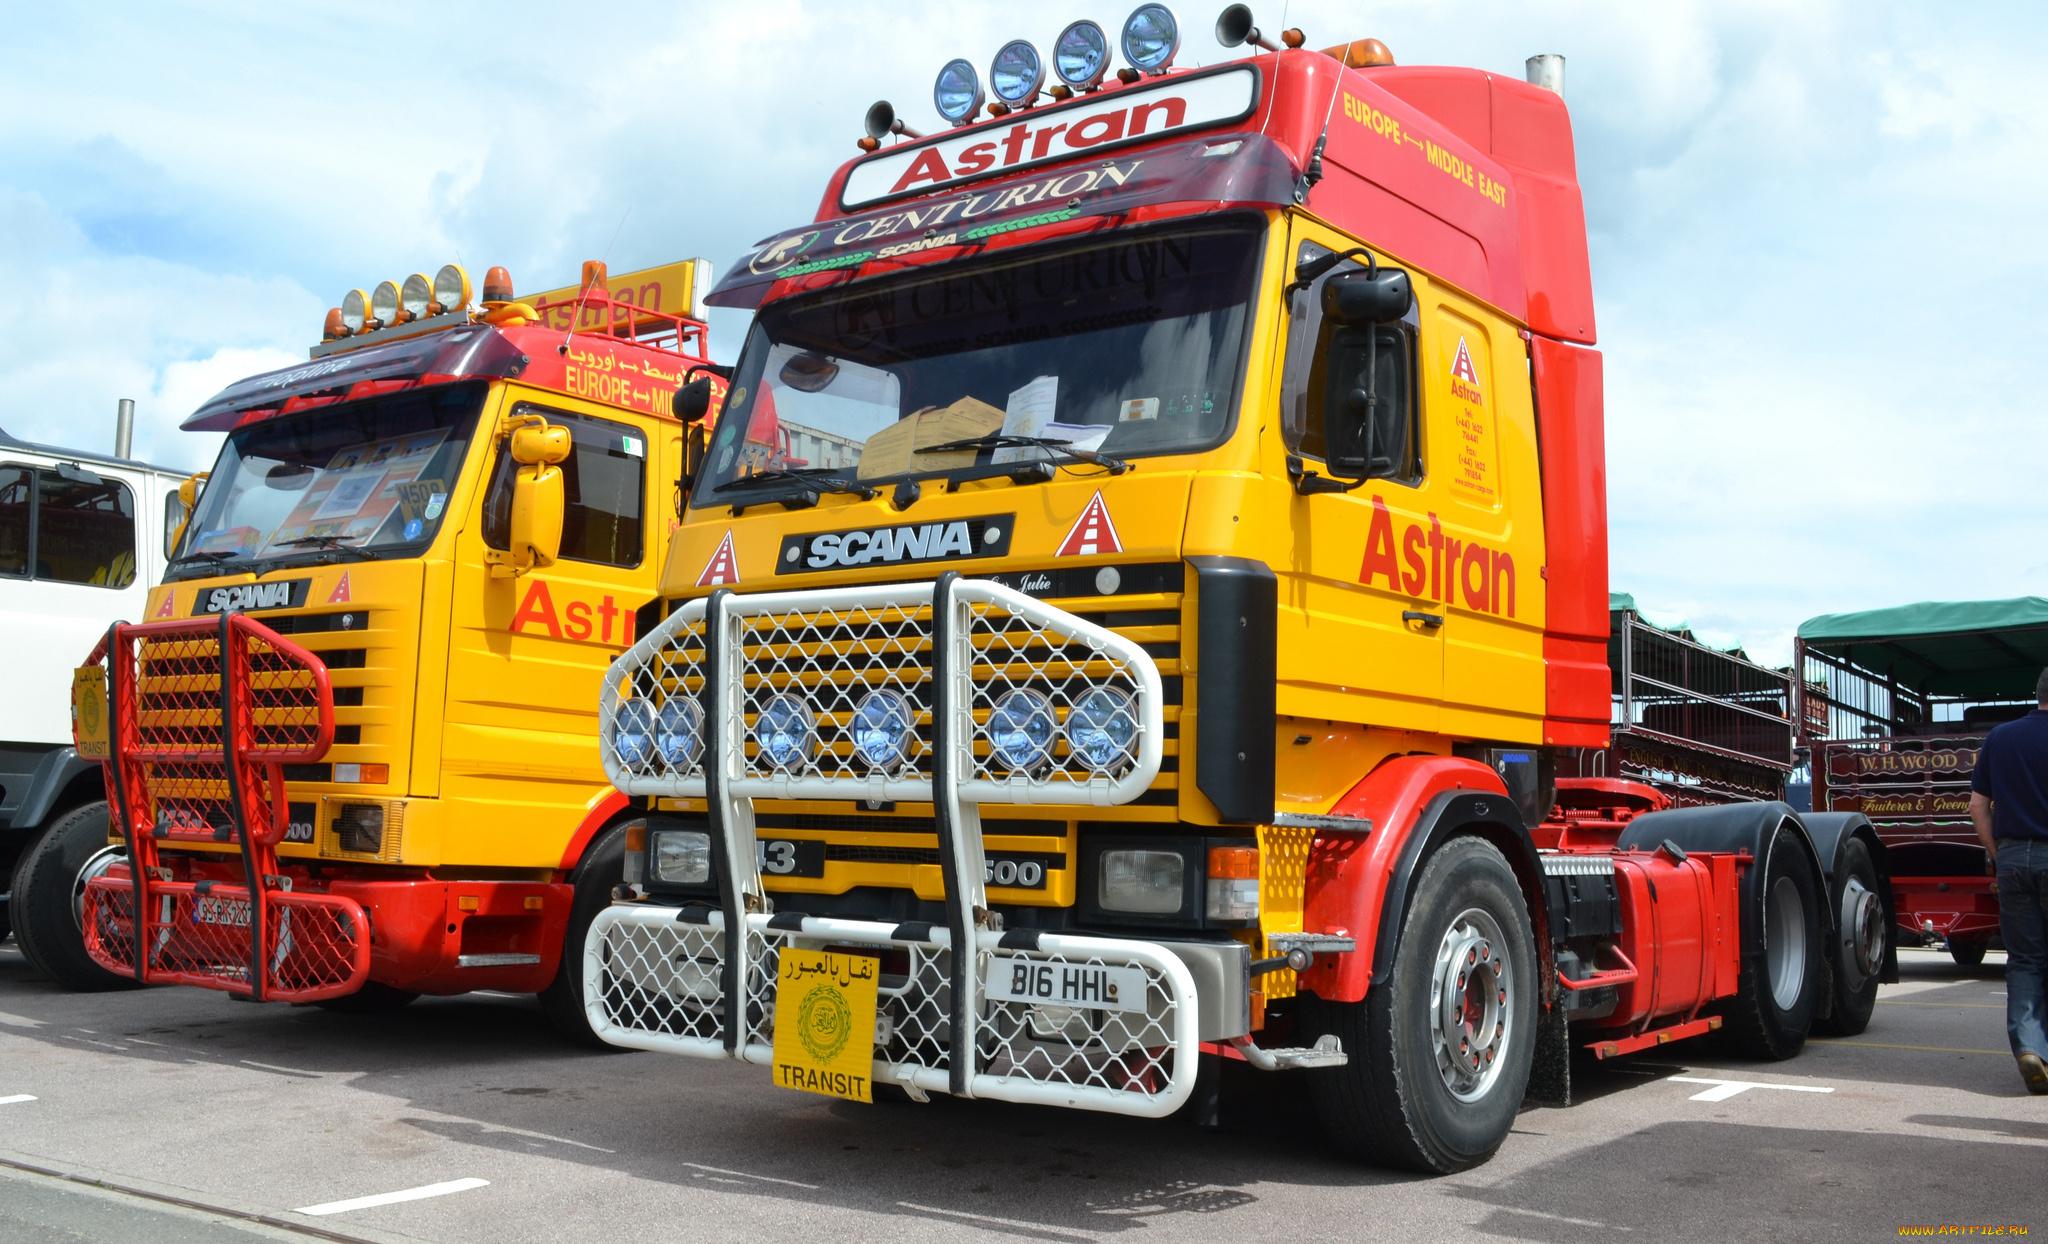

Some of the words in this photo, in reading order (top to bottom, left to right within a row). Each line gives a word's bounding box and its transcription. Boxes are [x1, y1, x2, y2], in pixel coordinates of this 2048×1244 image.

[888, 97, 1186, 194] Astran
[1343, 91, 1401, 145] EUROPE
[1426, 139, 1474, 188] MIDDLE
[1479, 171, 1506, 208] EAST
[834, 161, 1144, 246] CENTURION
[877, 233, 957, 259] SCANIA
[566, 365, 631, 407] EUROPE
[1451, 378, 1482, 406] Astran
[807, 521, 972, 568] SCANIA
[1358, 494, 1516, 618] Astran
[207, 582, 289, 612] SCANIA
[1018, 574, 1051, 594] Julie
[508, 579, 636, 646] Astr
[80, 741, 107, 755] TRANSIT
[1901, 754, 1958, 769] WOOD
[1861, 799, 1912, 812] Fruiterer
[1010, 964, 1053, 997] B16
[1062, 967, 1119, 1004] HHL
[779, 1064, 866, 1097] TRANSIT
